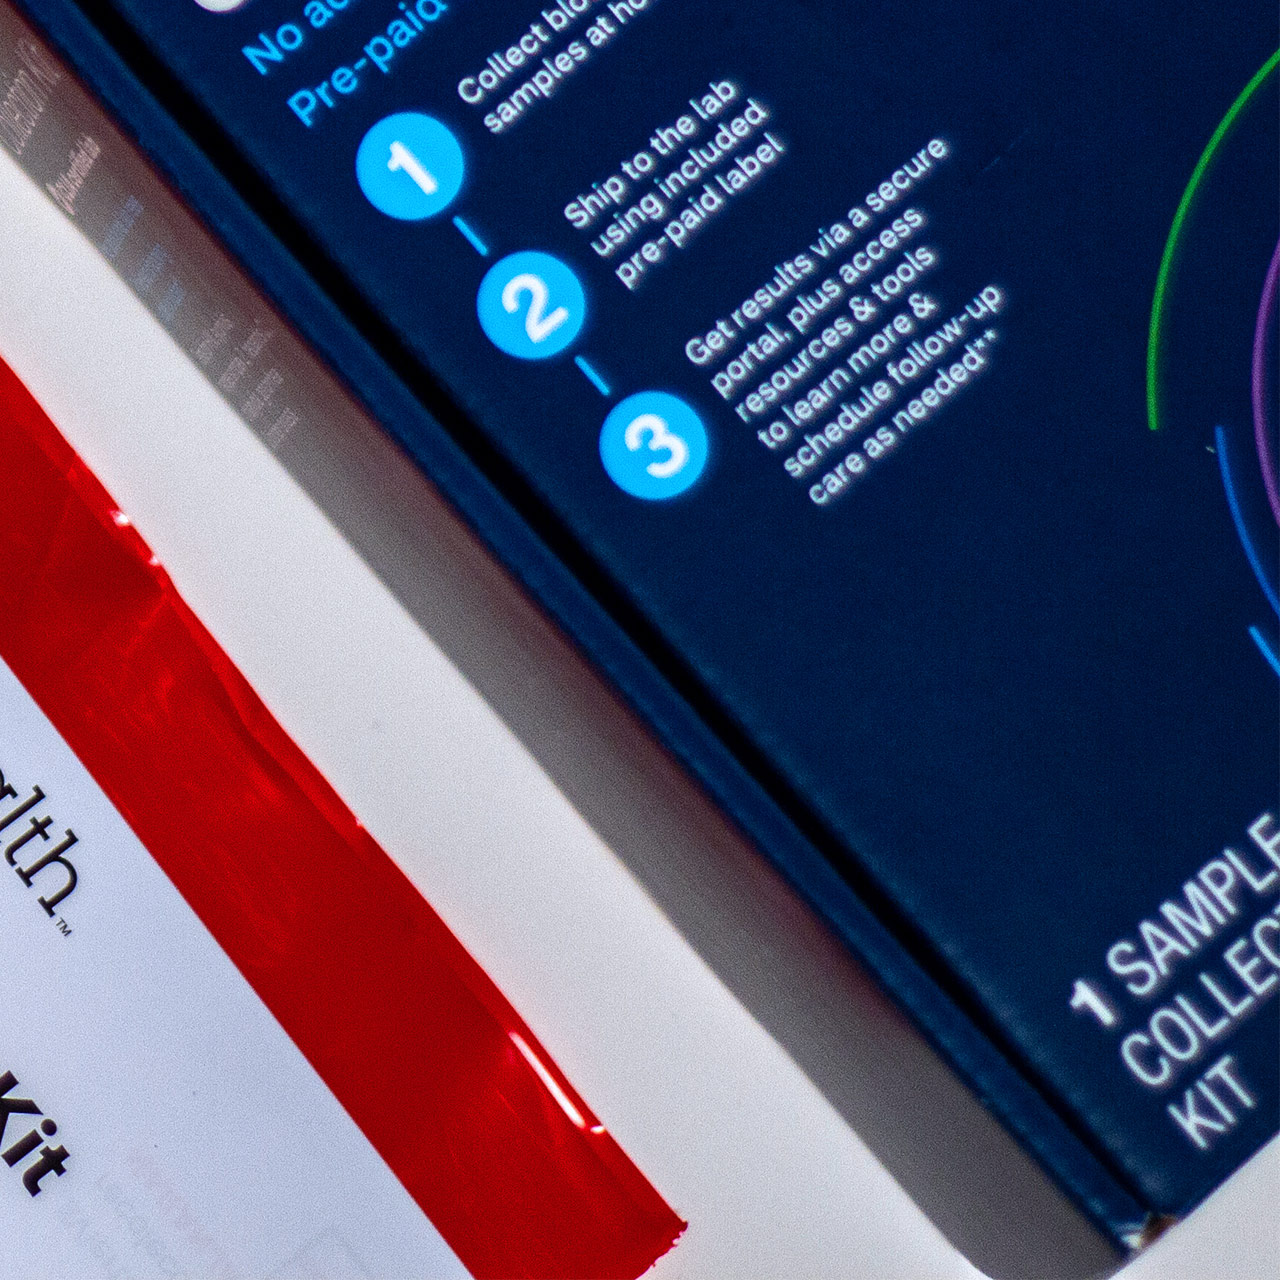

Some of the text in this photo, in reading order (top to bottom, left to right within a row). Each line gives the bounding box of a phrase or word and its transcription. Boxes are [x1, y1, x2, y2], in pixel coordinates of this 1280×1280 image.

[240, 18, 306, 76] No
[454, 21, 552, 106] Collect
[479, 37, 592, 136] samples
[582, 13, 617, 48] at
[383, 138, 439, 199] 1
[561, 77, 738, 231] Ship to the lab
[586, 96, 770, 259] using included
[611, 130, 785, 291] pre-paid label
[497, 268, 571, 345] 2
[682, 136, 950, 367] Get results via a secure
[707, 206, 926, 400] portal, plus access
[731, 243, 937, 424] resources & tools
[755, 290, 937, 451] to learn more &
[779, 282, 1006, 479] schedule follow-up
[620, 408, 693, 482] 3
[805, 449, 869, 507] care
[860, 422, 899, 460] as
[1070, 813, 1280, 1029] 1 SAMPLE
[1120, 905, 1280, 1088] COLLEC
[1167, 1053, 1256, 1151] KIT
